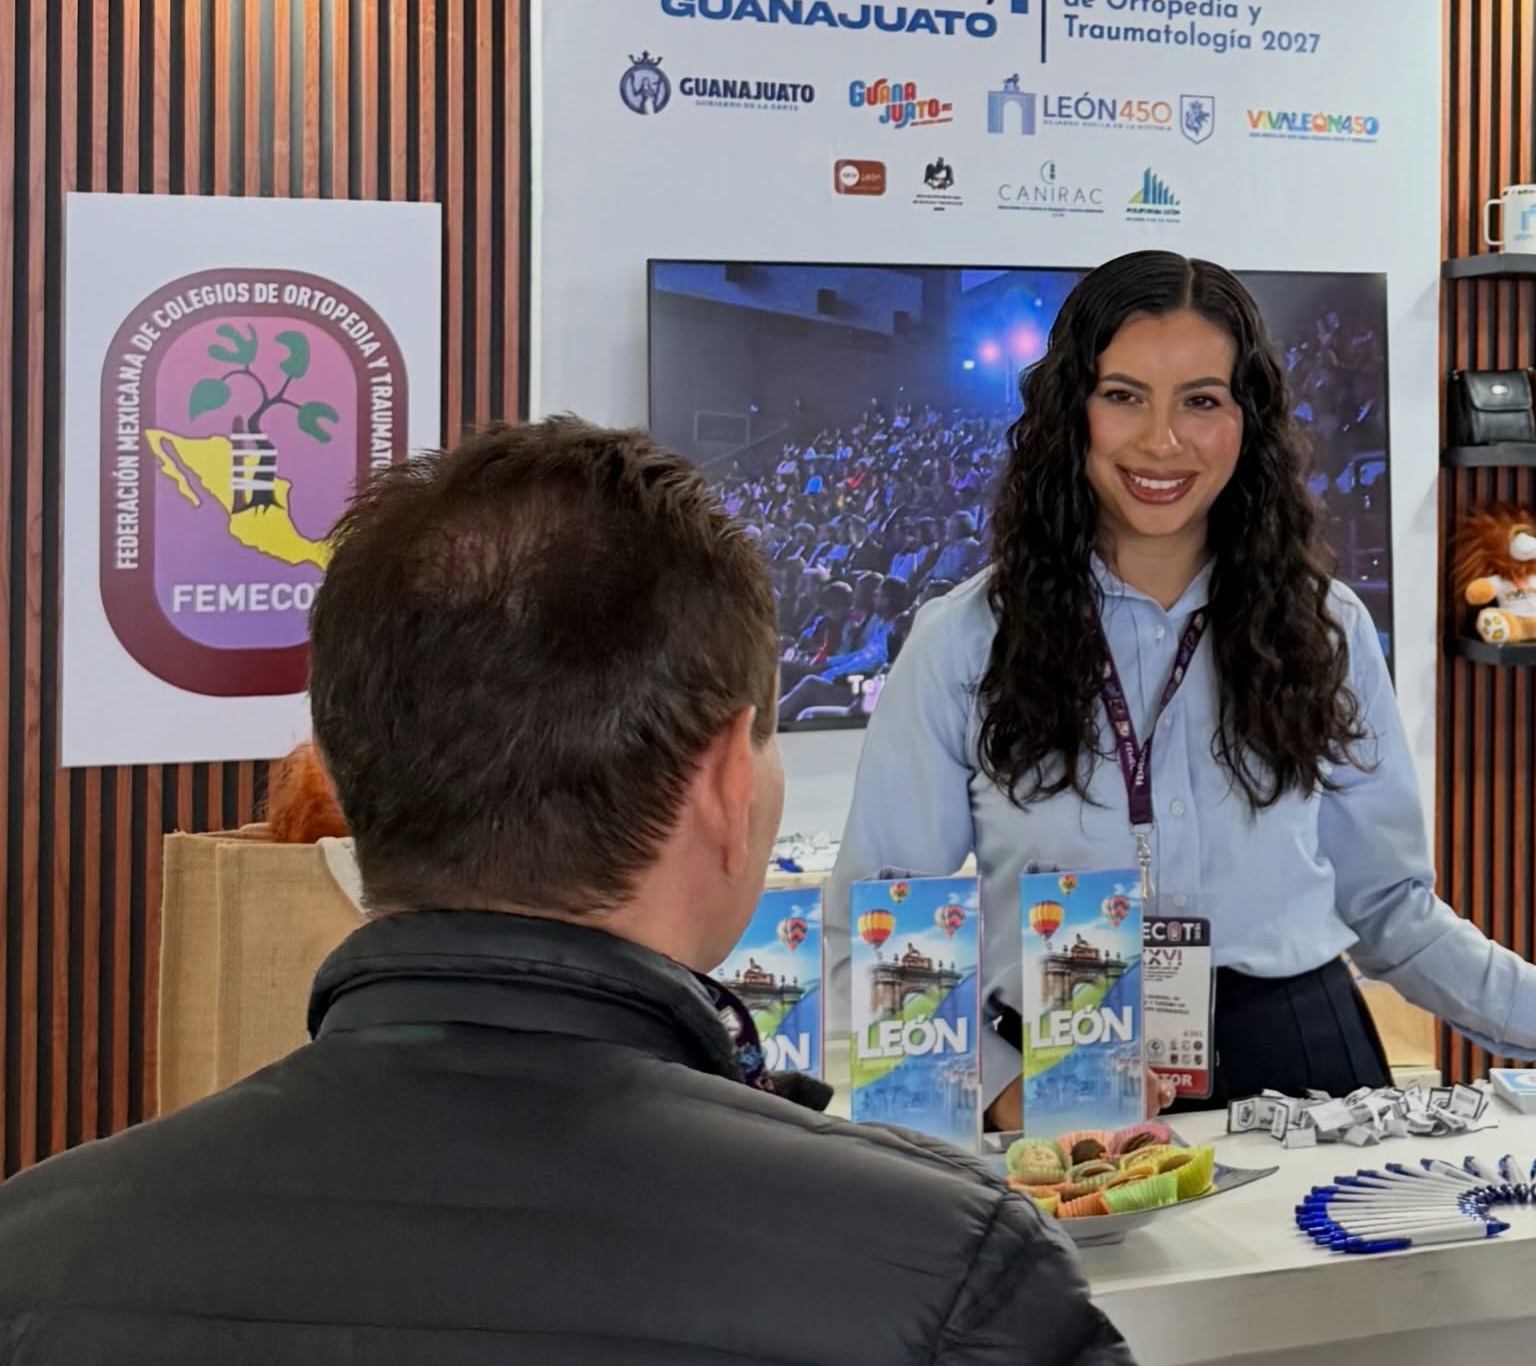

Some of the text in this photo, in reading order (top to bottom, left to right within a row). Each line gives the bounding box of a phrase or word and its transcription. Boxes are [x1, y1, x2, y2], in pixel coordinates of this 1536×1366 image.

[1248, 6, 1262, 25] y
[1063, 14, 1321, 53] Traumatología 2027
[679, 77, 815, 103] GUANAJUATO
[998, 184, 1103, 205] CANIRAC
[112, 282, 394, 569] FEDERACIÓN MEXICANA DE COLEGIOS DE ORTOPEDIA Y TRAUMATO
[171, 582, 324, 613] FEMECO
[856, 1013, 969, 1060] LEÓN
[1030, 1003, 1134, 1050] LEÓN
